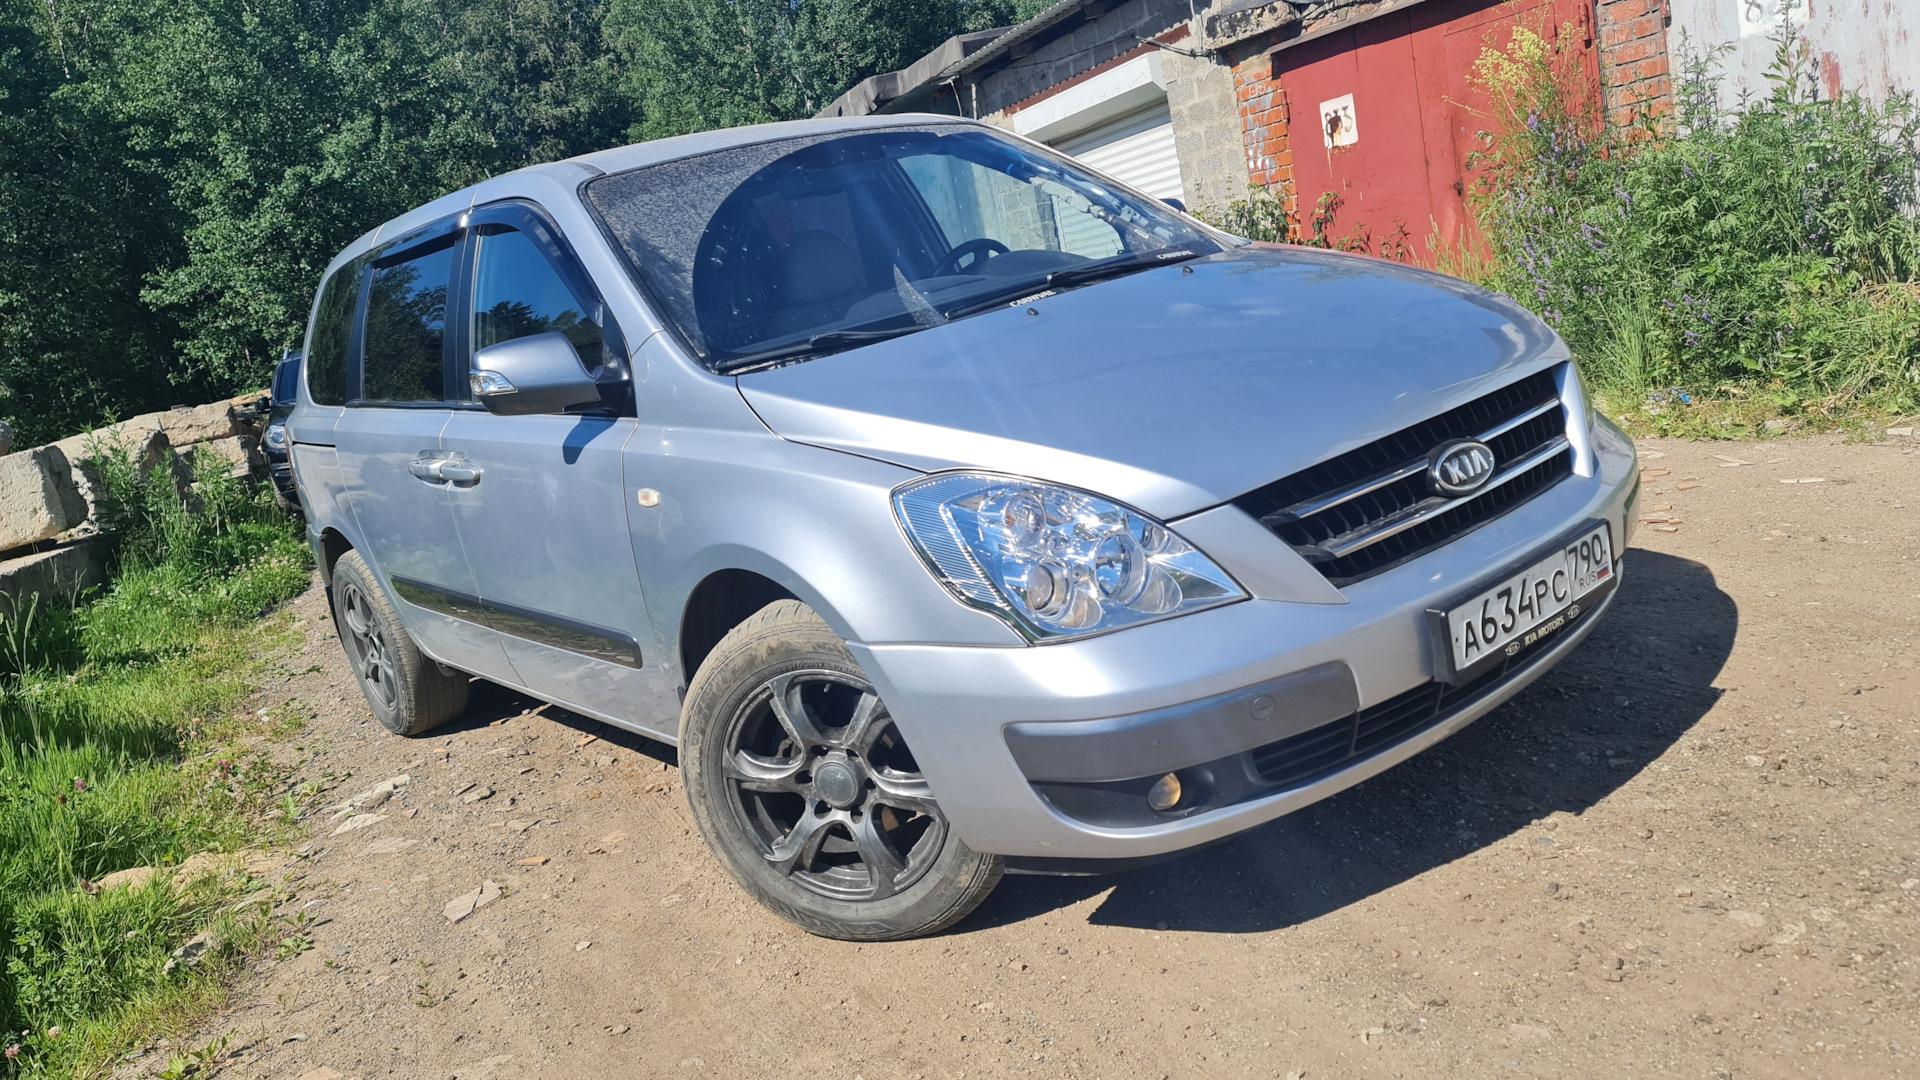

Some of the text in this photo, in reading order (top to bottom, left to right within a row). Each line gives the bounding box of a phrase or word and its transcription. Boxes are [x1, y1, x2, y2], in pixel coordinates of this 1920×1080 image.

[1009, 290, 1057, 307] CARNIVAL
[1443, 450, 1489, 484] KIA
[1568, 534, 1603, 581] 790
[1579, 572, 1597, 590] RUS
[1525, 615, 1565, 646] KIA MOTORS
